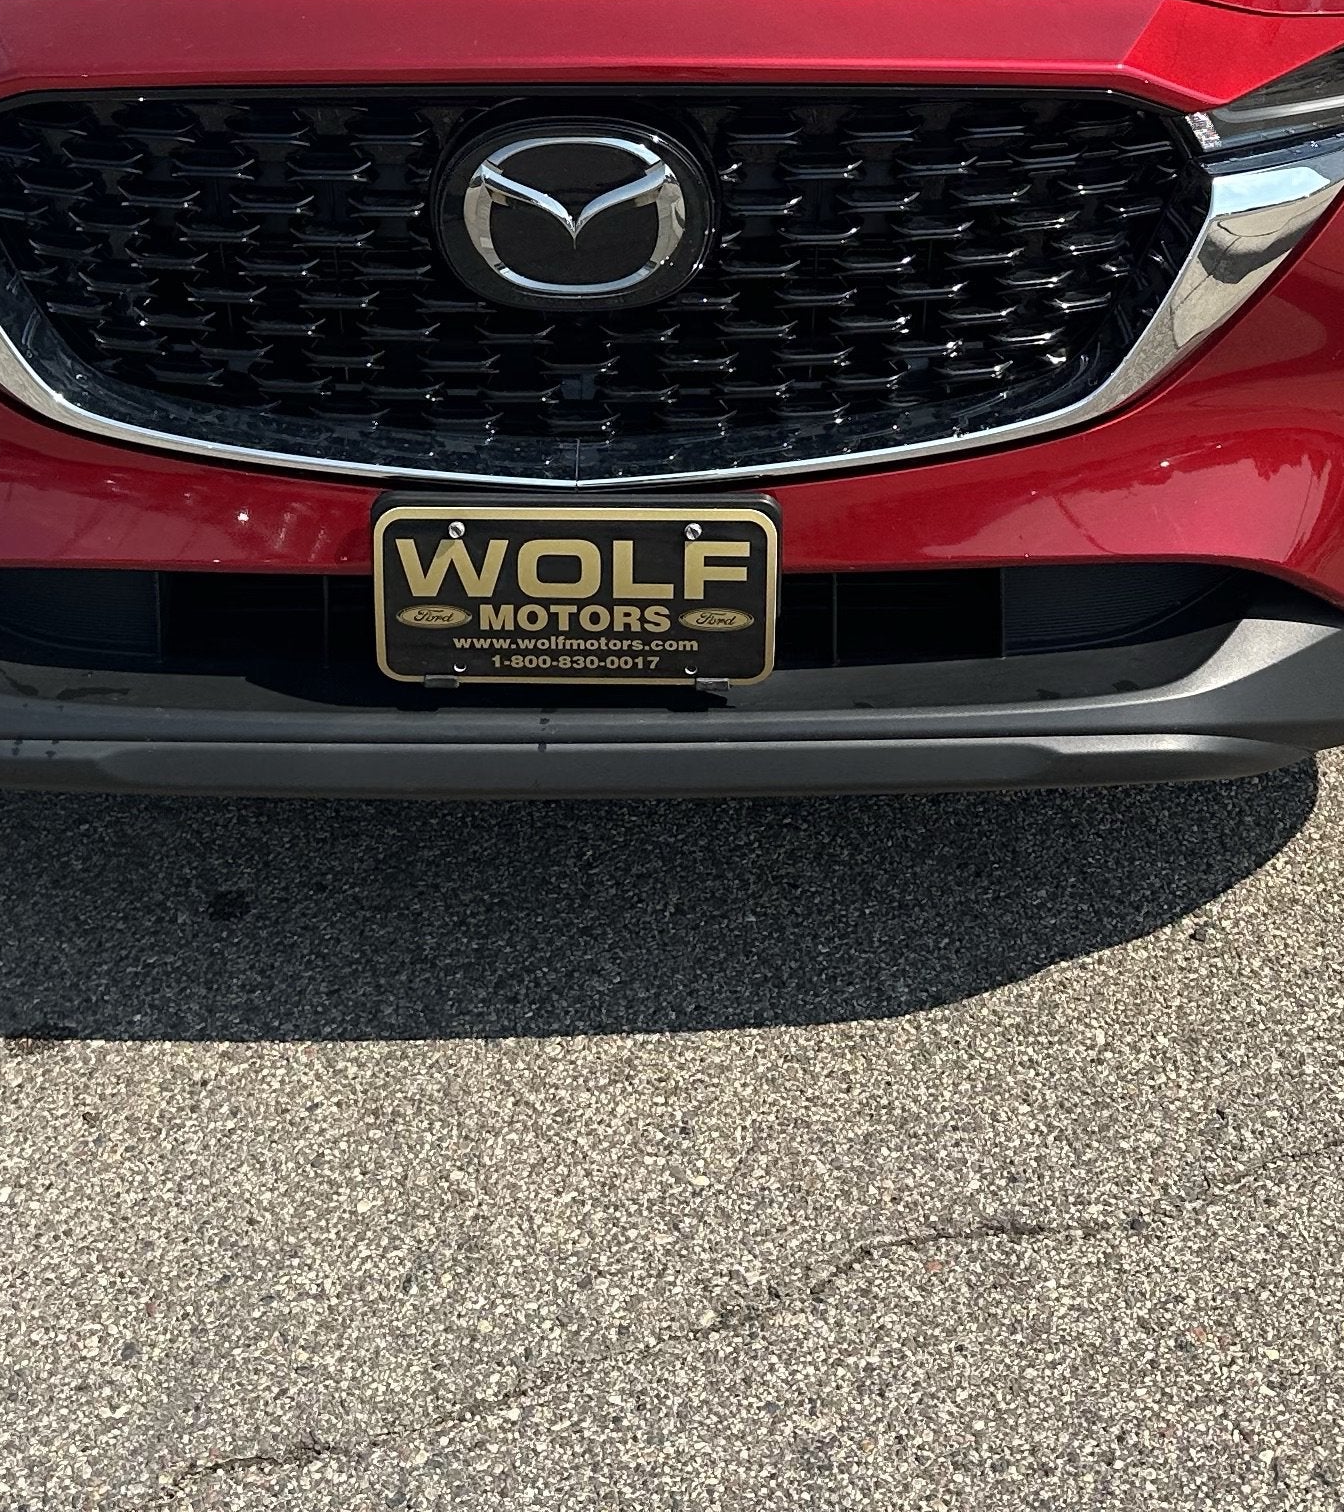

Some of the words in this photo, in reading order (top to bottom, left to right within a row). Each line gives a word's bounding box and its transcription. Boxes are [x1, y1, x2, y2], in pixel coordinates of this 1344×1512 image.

[395, 538, 751, 601] WOLF
[412, 609, 455, 624] Ford
[479, 603, 672, 633] MOTORS
[694, 611, 737, 627] Ford
[452, 635, 699, 652] www.wolfmotors.com
[491, 654, 661, 671] 1-800-830-0017
